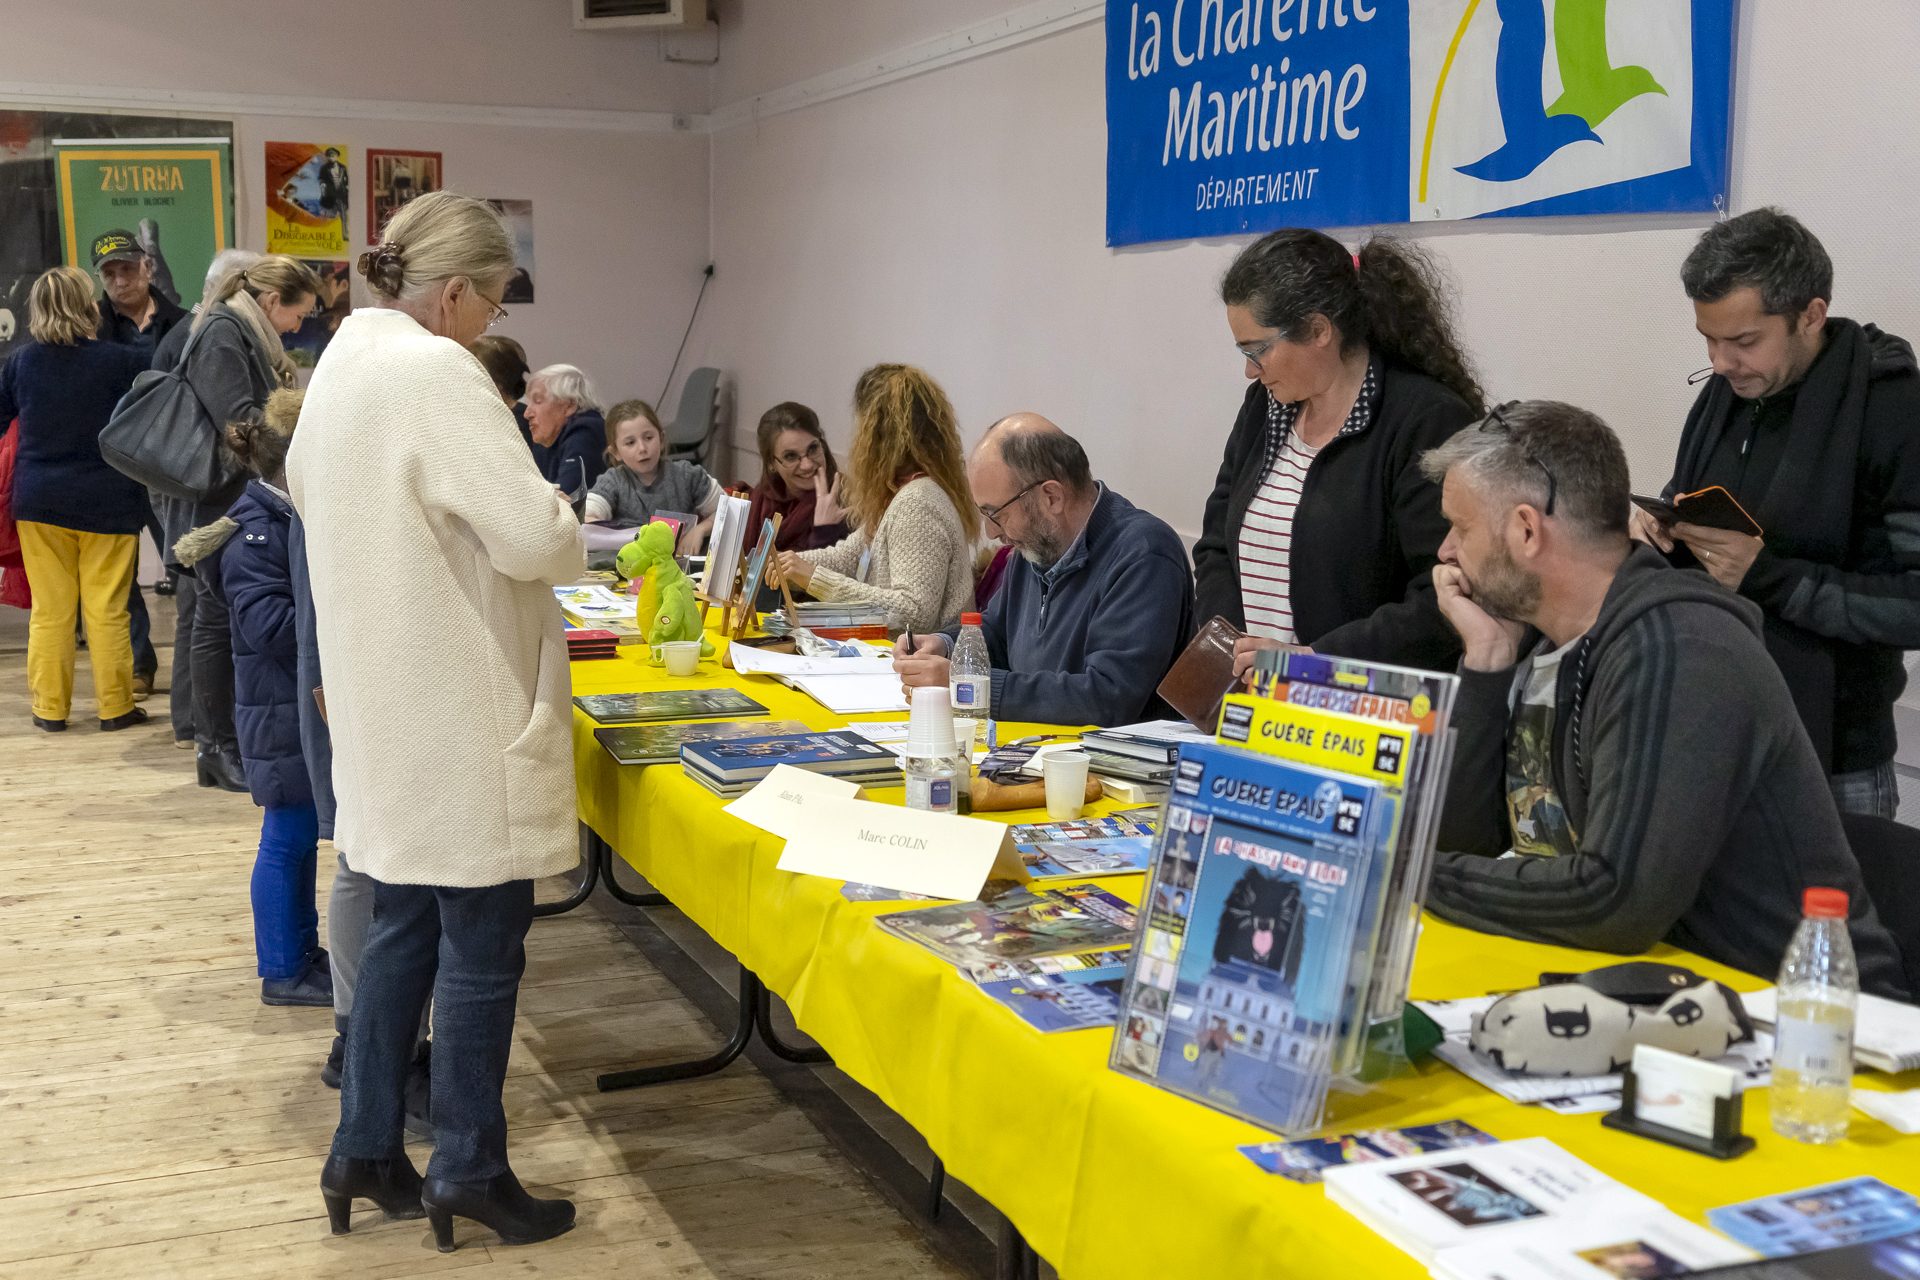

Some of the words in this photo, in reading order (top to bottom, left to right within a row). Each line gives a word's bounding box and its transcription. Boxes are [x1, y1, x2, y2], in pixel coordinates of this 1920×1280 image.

[1128, 2, 1162, 81] la
[1162, 57, 1367, 167] Maritime
[99, 165, 184, 191] ZUTRHA
[1196, 169, 1319, 211] DÉPARTEMENT
[857, 829, 886, 844] Marc
[889, 834, 928, 850] COLIN
